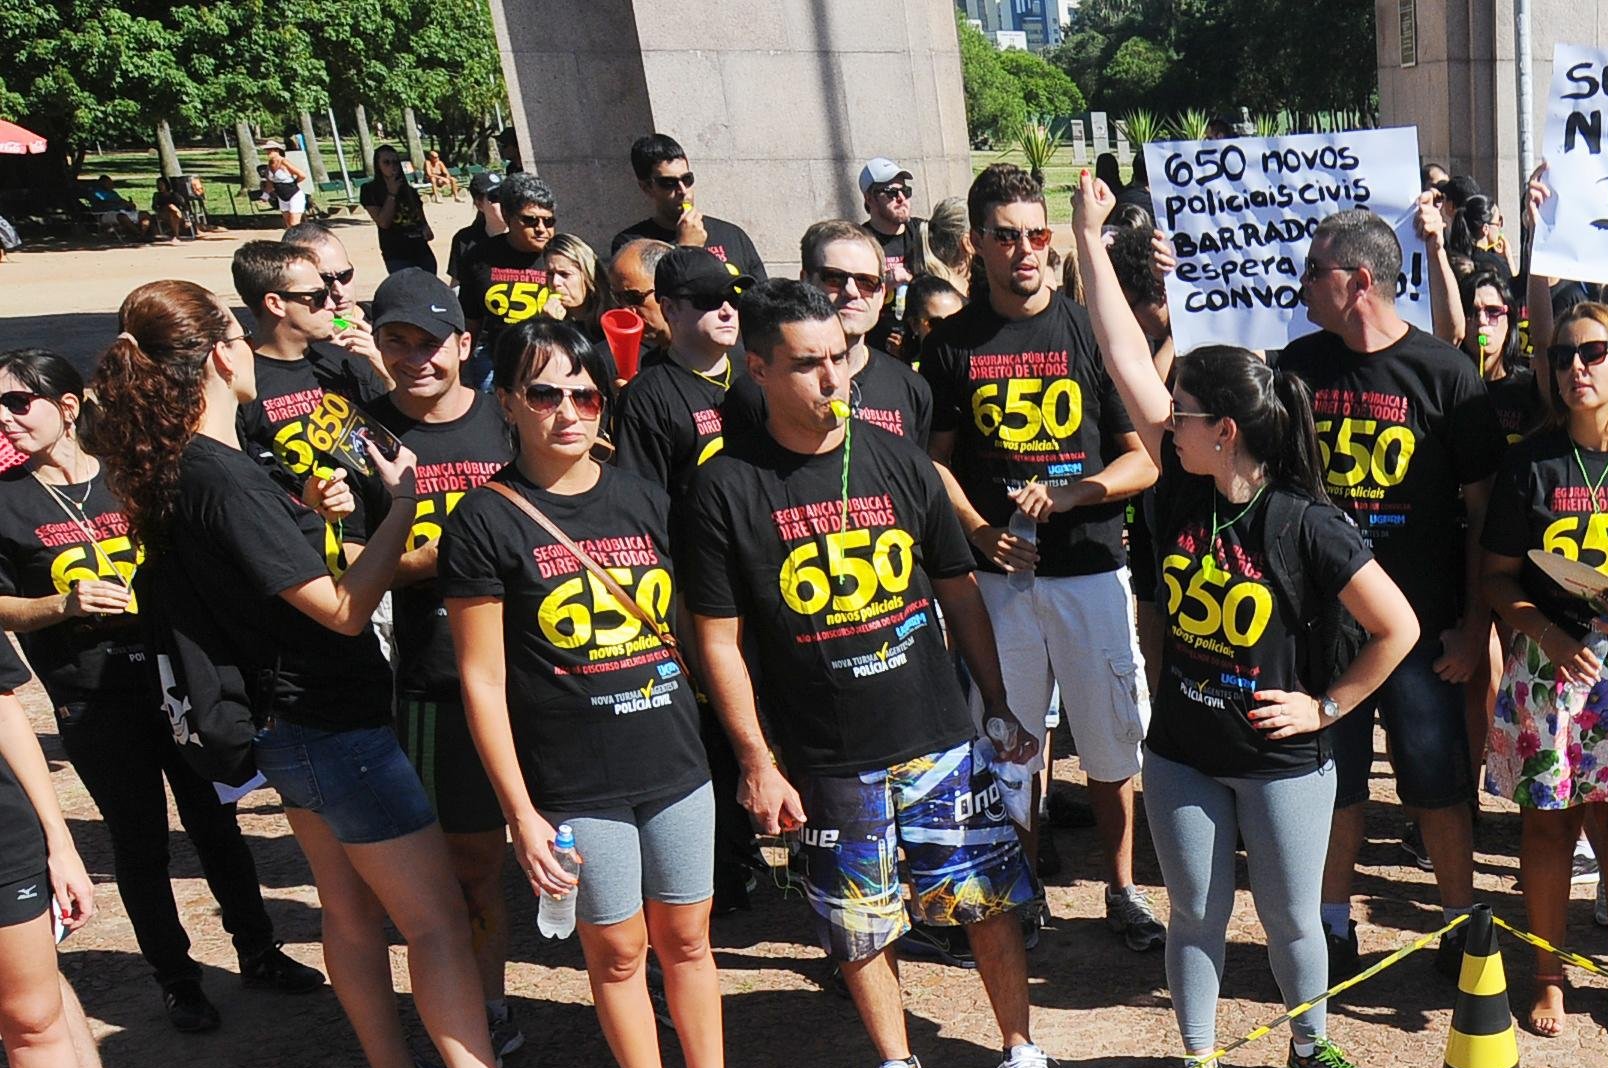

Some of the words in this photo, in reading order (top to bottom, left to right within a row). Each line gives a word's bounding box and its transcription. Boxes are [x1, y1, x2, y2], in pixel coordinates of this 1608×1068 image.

[1165, 145, 1246, 187] 650
[1262, 146, 1359, 174] novos
[1166, 183, 1294, 231] policiais
[1299, 178, 1370, 202] civis
[1176, 256, 1296, 283] espera
[1015, 364, 1030, 377] DE
[263, 390, 312, 410] SEGURANÇA
[972, 378, 1082, 442] 650
[267, 401, 311, 423] DIREITO
[307, 393, 349, 451] 650
[1369, 404, 1406, 423] TODOS
[449, 475, 468, 490] DE
[1344, 485, 1385, 499] policiais
[850, 509, 895, 528] TODOS
[93, 526, 110, 540] DE
[596, 535, 645, 552] PÚBLICA
[611, 549, 658, 567] TODOS
[779, 528, 914, 615] 650
[538, 568, 672, 649] 650
[826, 612, 860, 625] novos
[860, 596, 904, 622] policiais
[589, 645, 625, 661] novos
[626, 634, 661, 656] policia
[1194, 637, 1235, 659] policiais
[583, 663, 620, 674] DISCURSO
[853, 660, 888, 678] POLÍCIA
[590, 695, 614, 706] NOVA
[615, 690, 642, 702] TURMA
[614, 698, 651, 715] POLÍCIA
[652, 693, 672, 708] CIVIL
[1204, 693, 1225, 710] CIVIL
